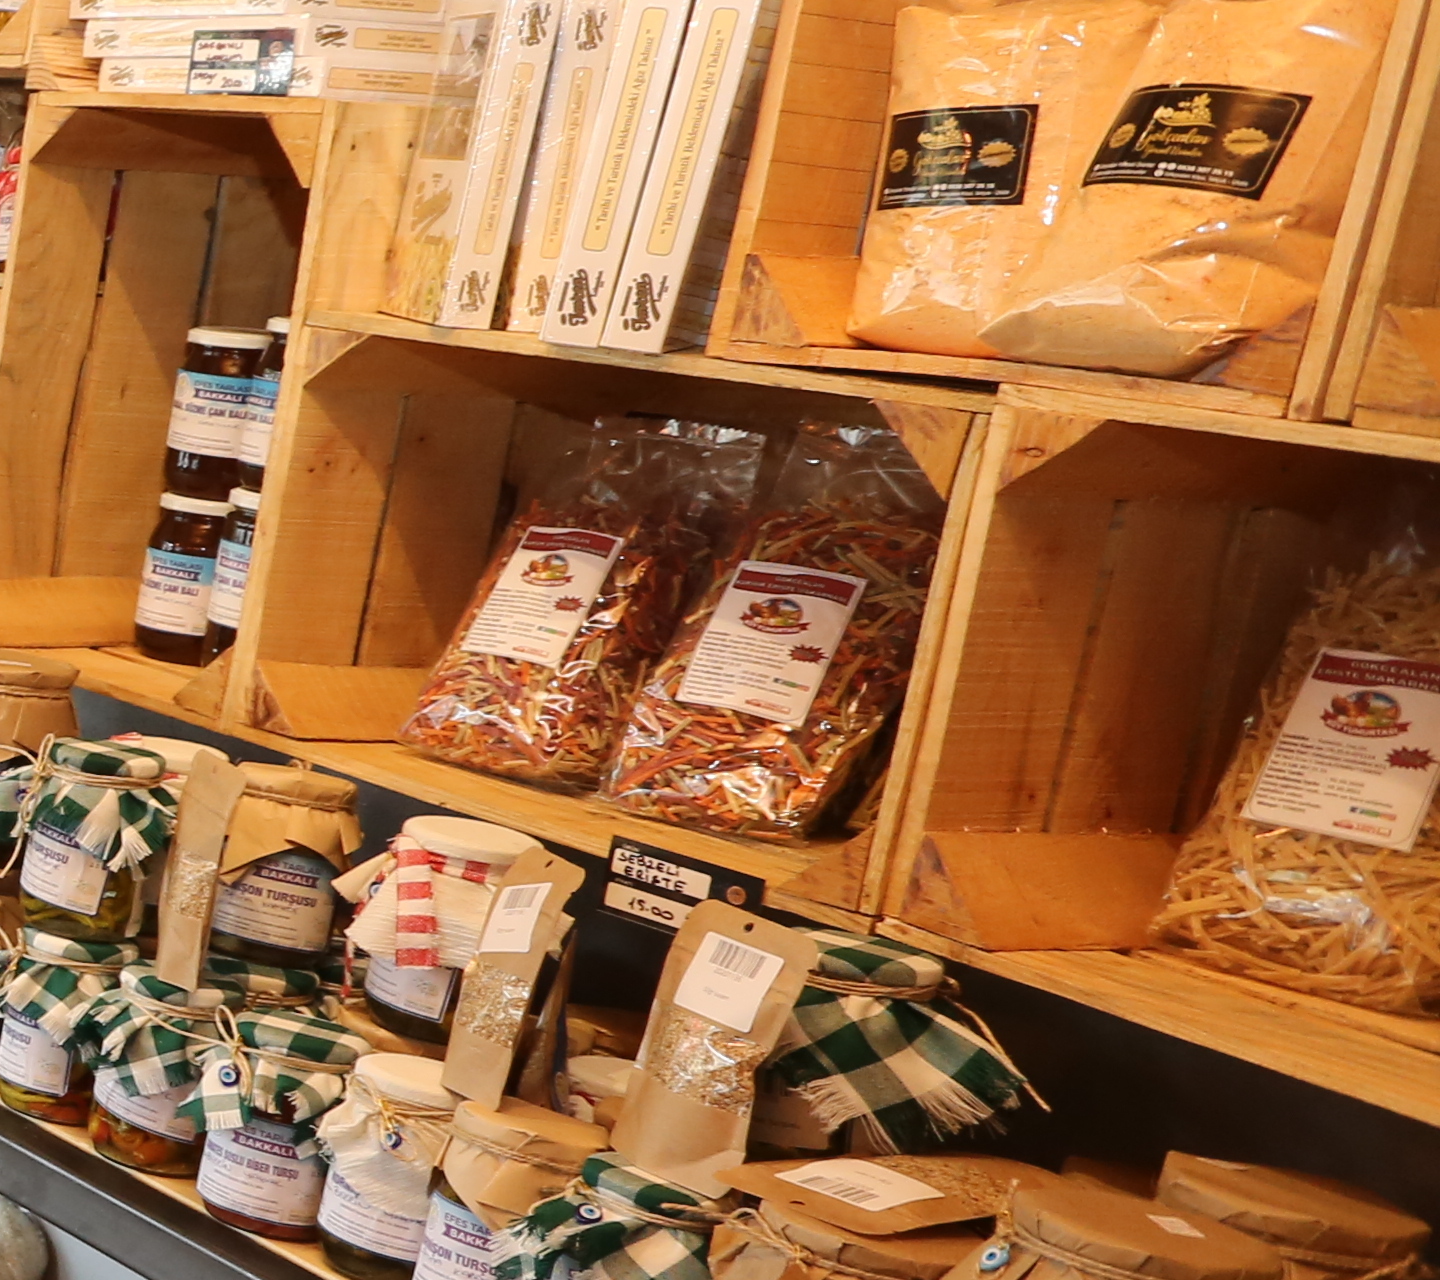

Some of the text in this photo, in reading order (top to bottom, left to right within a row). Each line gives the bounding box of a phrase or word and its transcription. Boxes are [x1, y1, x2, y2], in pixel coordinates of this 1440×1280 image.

[260, 870, 313, 885] BAKKALI
[267, 889, 317, 907] TURŞUSU
[237, 1134, 294, 1158] BAKKALI
[444, 1212, 468, 1231] EFES
